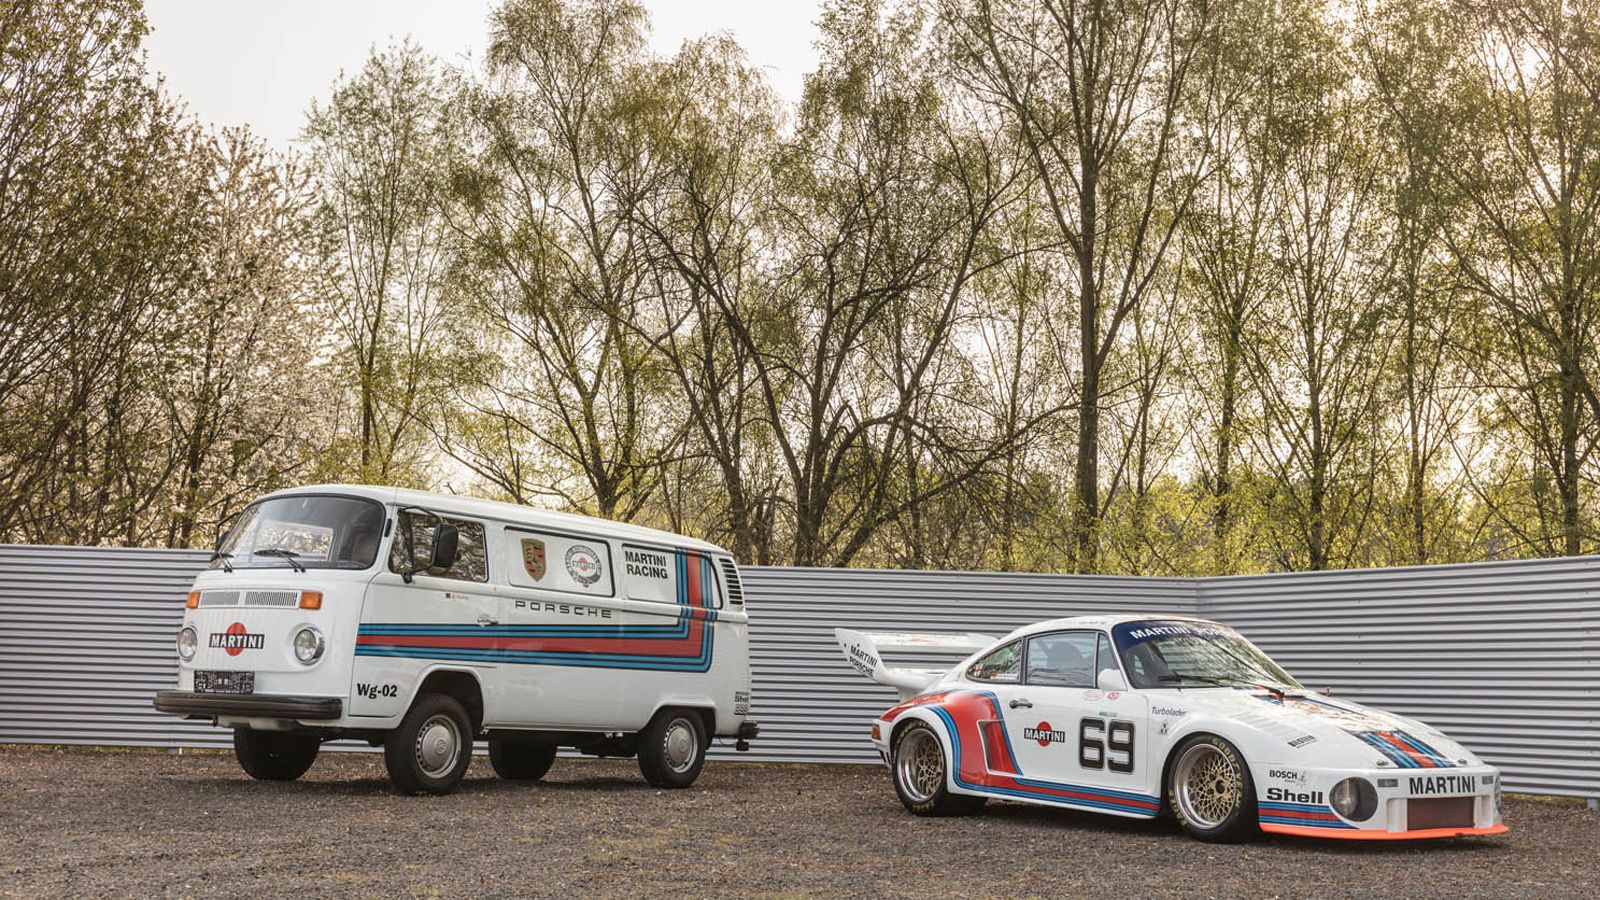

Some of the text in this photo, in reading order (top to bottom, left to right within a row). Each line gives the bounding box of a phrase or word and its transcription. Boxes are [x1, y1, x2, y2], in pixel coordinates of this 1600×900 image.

[625, 551, 666, 566] MARTINI
[627, 564, 668, 579] RACING
[515, 600, 612, 619] PORSCHE
[1130, 626, 1192, 639] MARTINI
[210, 634, 263, 648] MARTINI
[850, 644, 878, 668] MARTINI
[357, 683, 398, 699] Wg-02
[1152, 706, 1187, 717] Turbolader
[1024, 729, 1065, 743] MARTINI
[1079, 717, 1135, 774] 69
[1269, 770, 1298, 780] BOSCH
[1408, 776, 1476, 795] MARTINI
[1266, 788, 1323, 804] Shell
